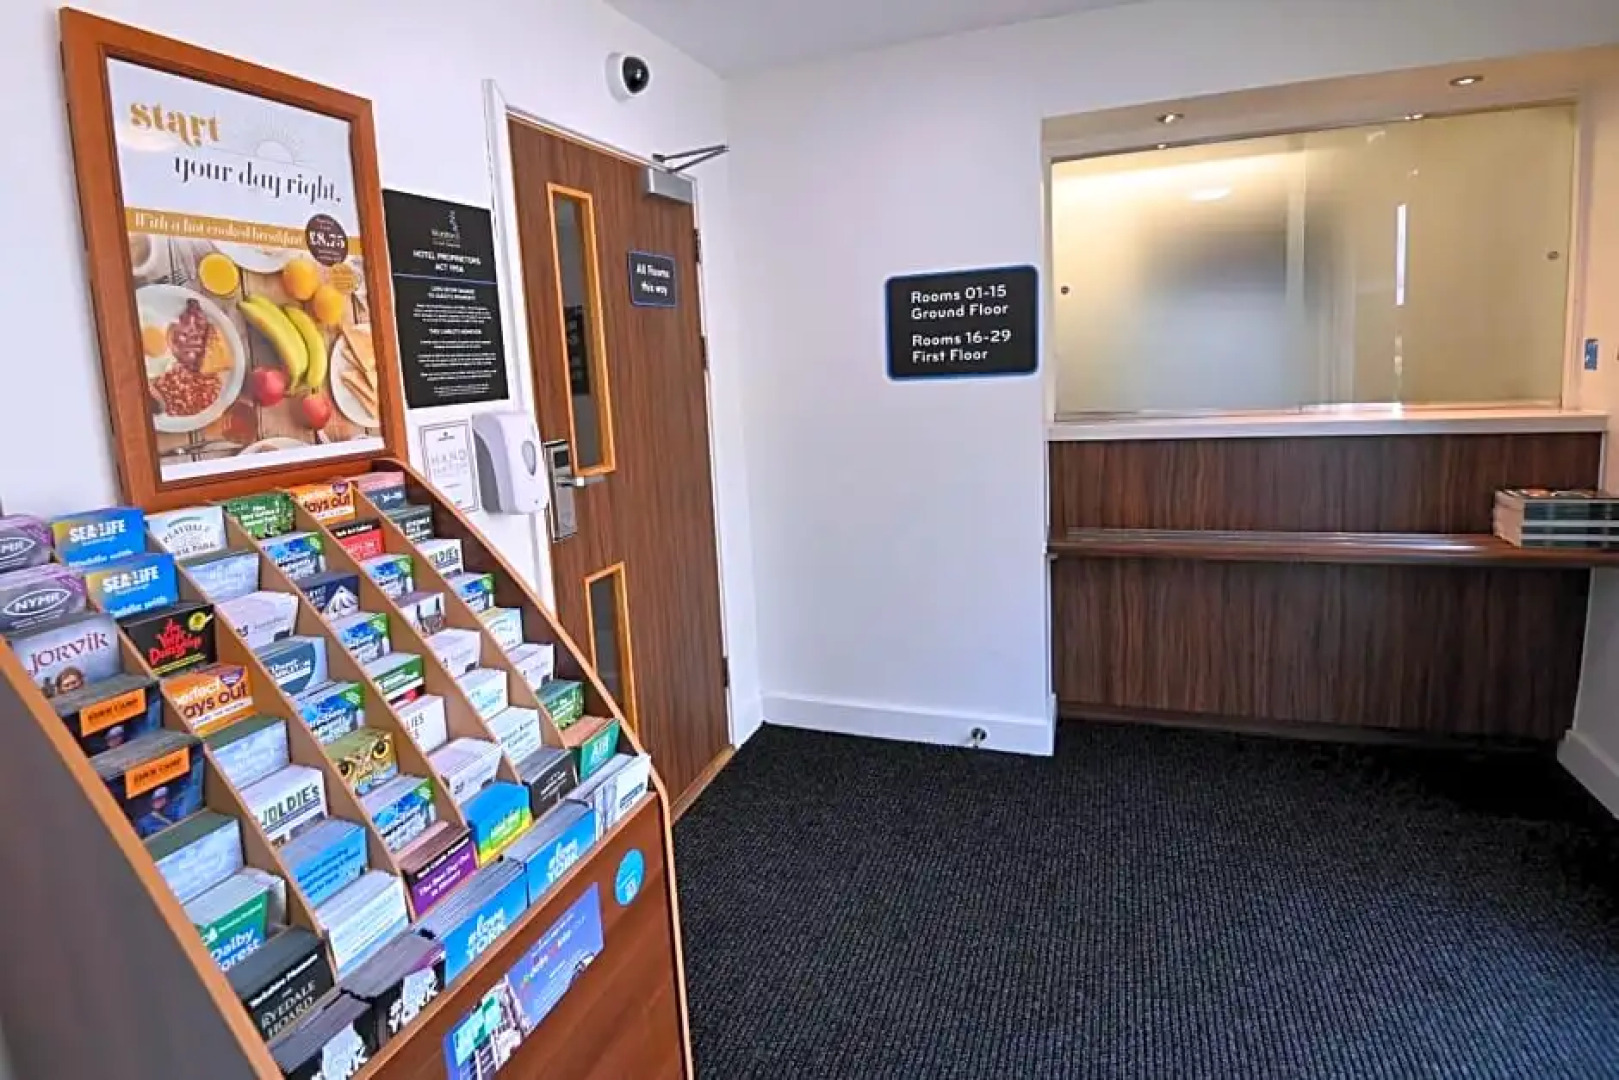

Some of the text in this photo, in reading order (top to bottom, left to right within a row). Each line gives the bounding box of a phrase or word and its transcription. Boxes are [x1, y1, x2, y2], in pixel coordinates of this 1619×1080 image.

[130, 102, 222, 147] start
[174, 156, 233, 184] your
[239, 161, 280, 199] day
[412, 249, 436, 262] HOTEL
[911, 284, 1007, 304] Rooms 01-15
[911, 302, 1009, 320] Ground Floor
[912, 329, 1012, 347] Rooms 16-29
[912, 348, 989, 364] First Floor
[69, 524, 97, 543] SEA
[98, 519, 126, 537] LIFE
[102, 564, 160, 593] SEA LIFE
[180, 697, 215, 719] ays
[218, 681, 247, 704] out
[211, 928, 255, 958] Dalby
[218, 938, 262, 973] orest
